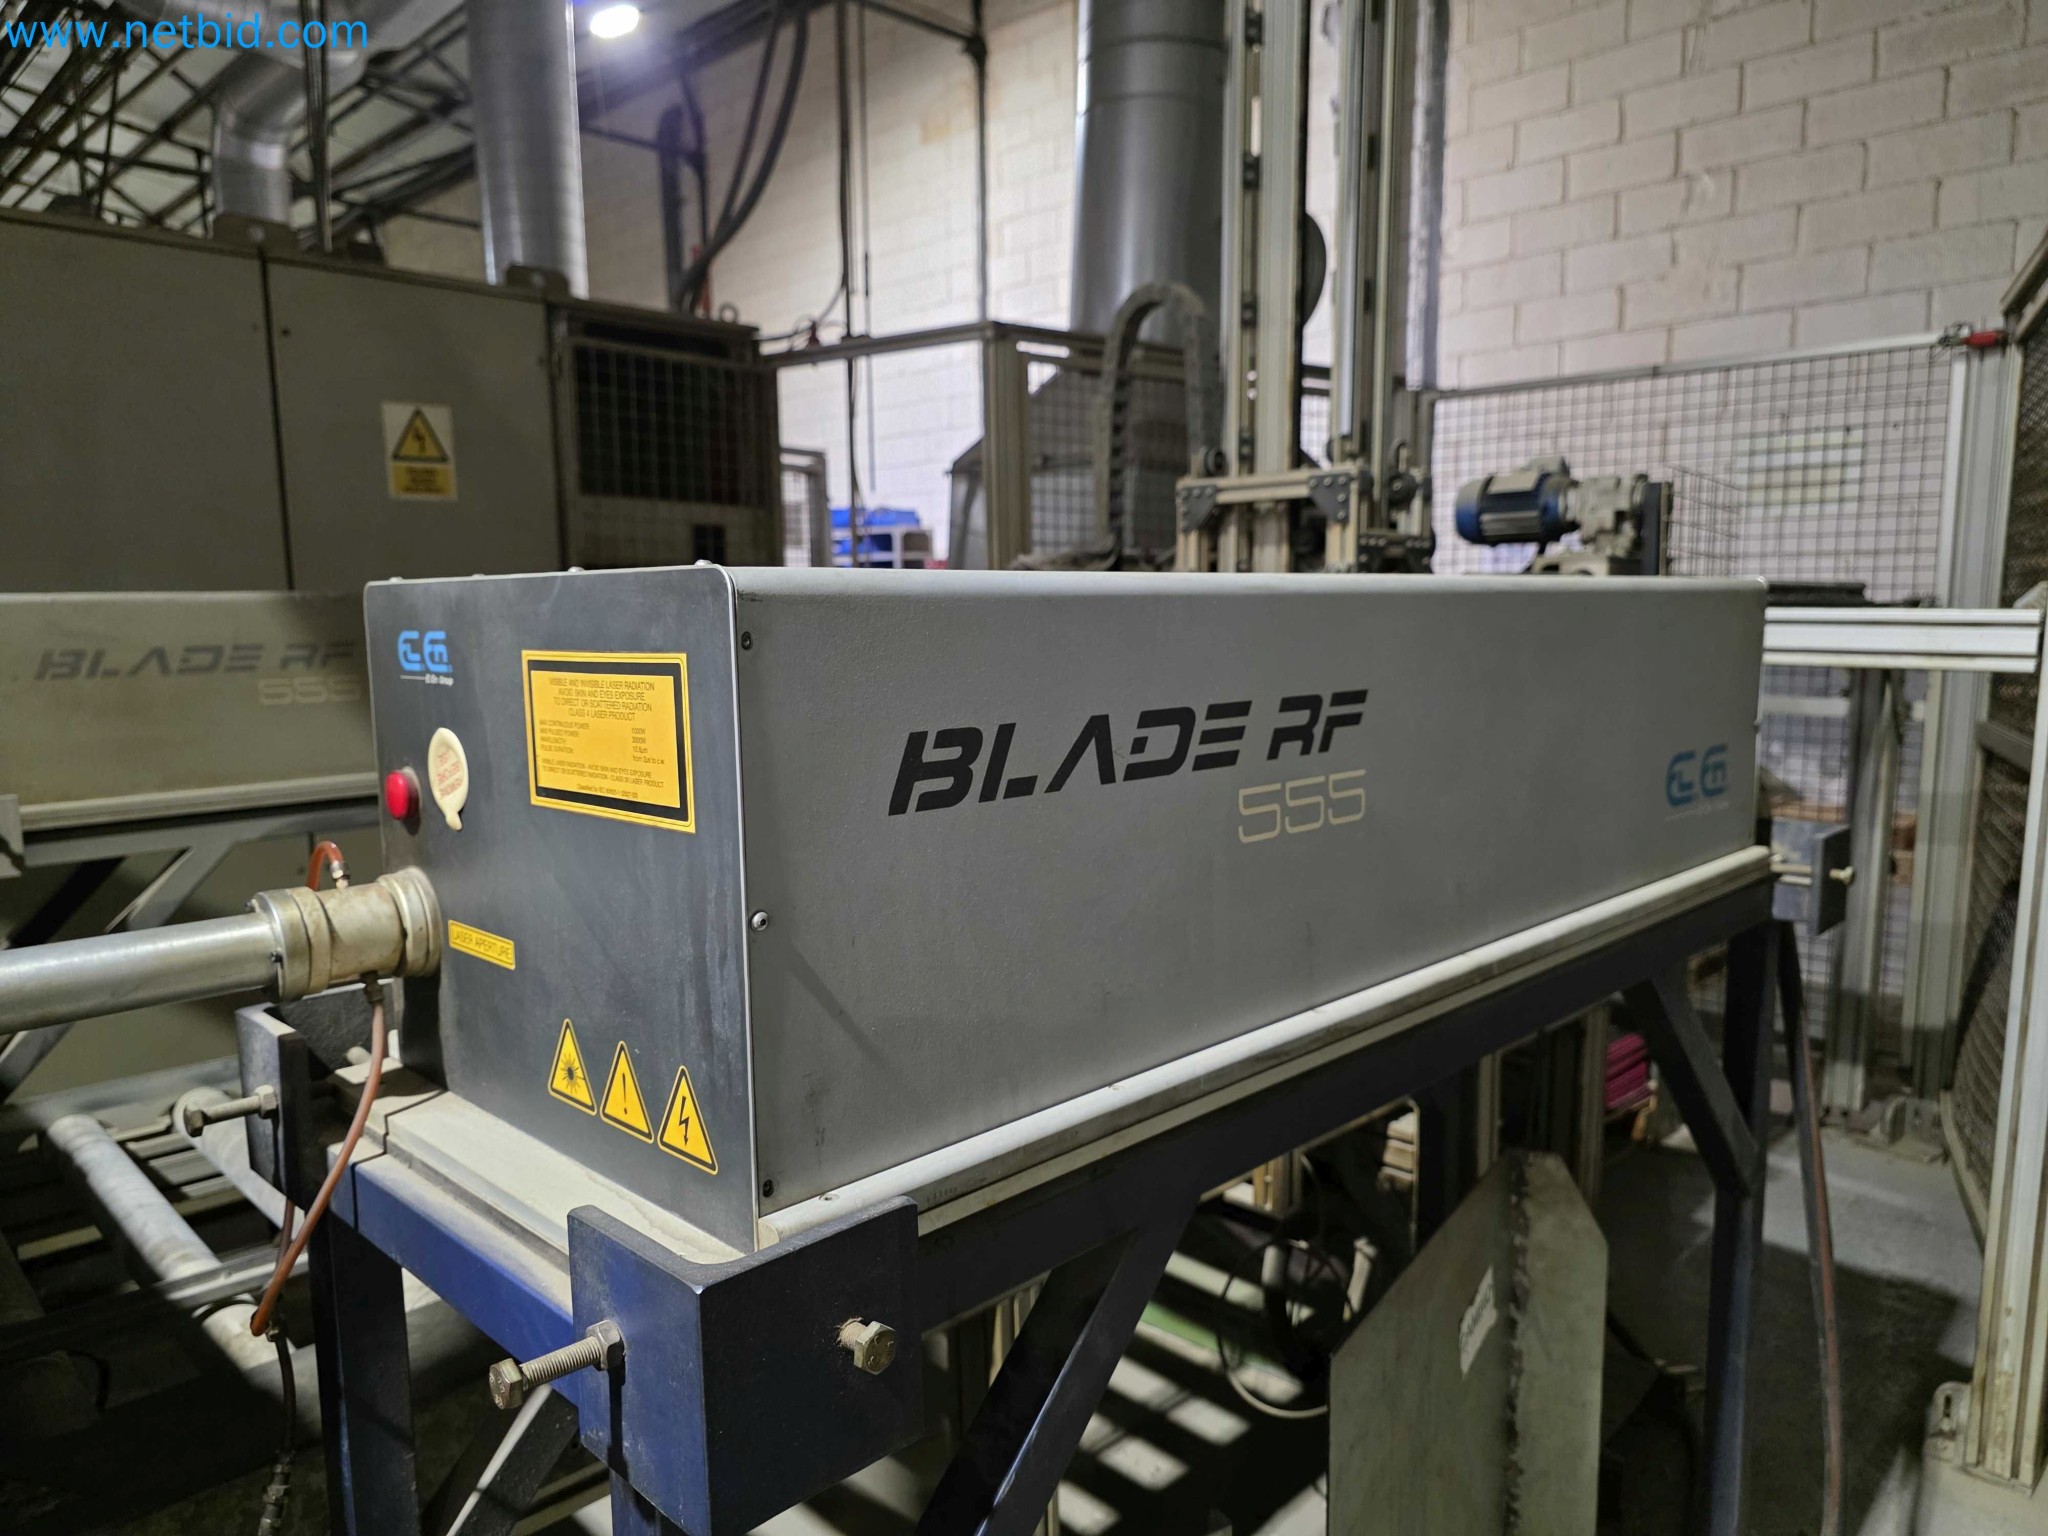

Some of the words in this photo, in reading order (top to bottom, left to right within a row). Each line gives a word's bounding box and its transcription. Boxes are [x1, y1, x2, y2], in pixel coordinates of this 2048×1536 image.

[34, 643, 266, 681] BLADE
[278, 640, 359, 671] RF
[258, 674, 362, 705] 555
[569, 679, 579, 688] AND
[581, 680, 605, 689] INVISIBLE
[606, 680, 624, 690] LASER
[624, 681, 655, 691] RADIATION
[558, 688, 574, 696] AVOID
[574, 689, 586, 697] SKIN
[588, 690, 599, 698] AND
[600, 690, 614, 700] EYES
[615, 691, 646, 701] EXPOSURE
[561, 697, 580, 706] DIRECT
[581, 699, 589, 707] OR
[590, 699, 620, 710] SCATTERED
[622, 701, 652, 712] RADIATION
[568, 708, 586, 717] CLASS
[590, 710, 607, 719] LASER
[608, 711, 636, 721] PRODUCT
[632, 727, 646, 735] 1000W
[632, 754, 642, 762] from
[888, 700, 1252, 816] BLADE
[1266, 689, 1368, 761] RF
[630, 769, 652, 779] EXPOSURE
[644, 779, 664, 788] PRODUCT
[1238, 768, 1367, 843] 555
[452, 927, 473, 945] LASER
